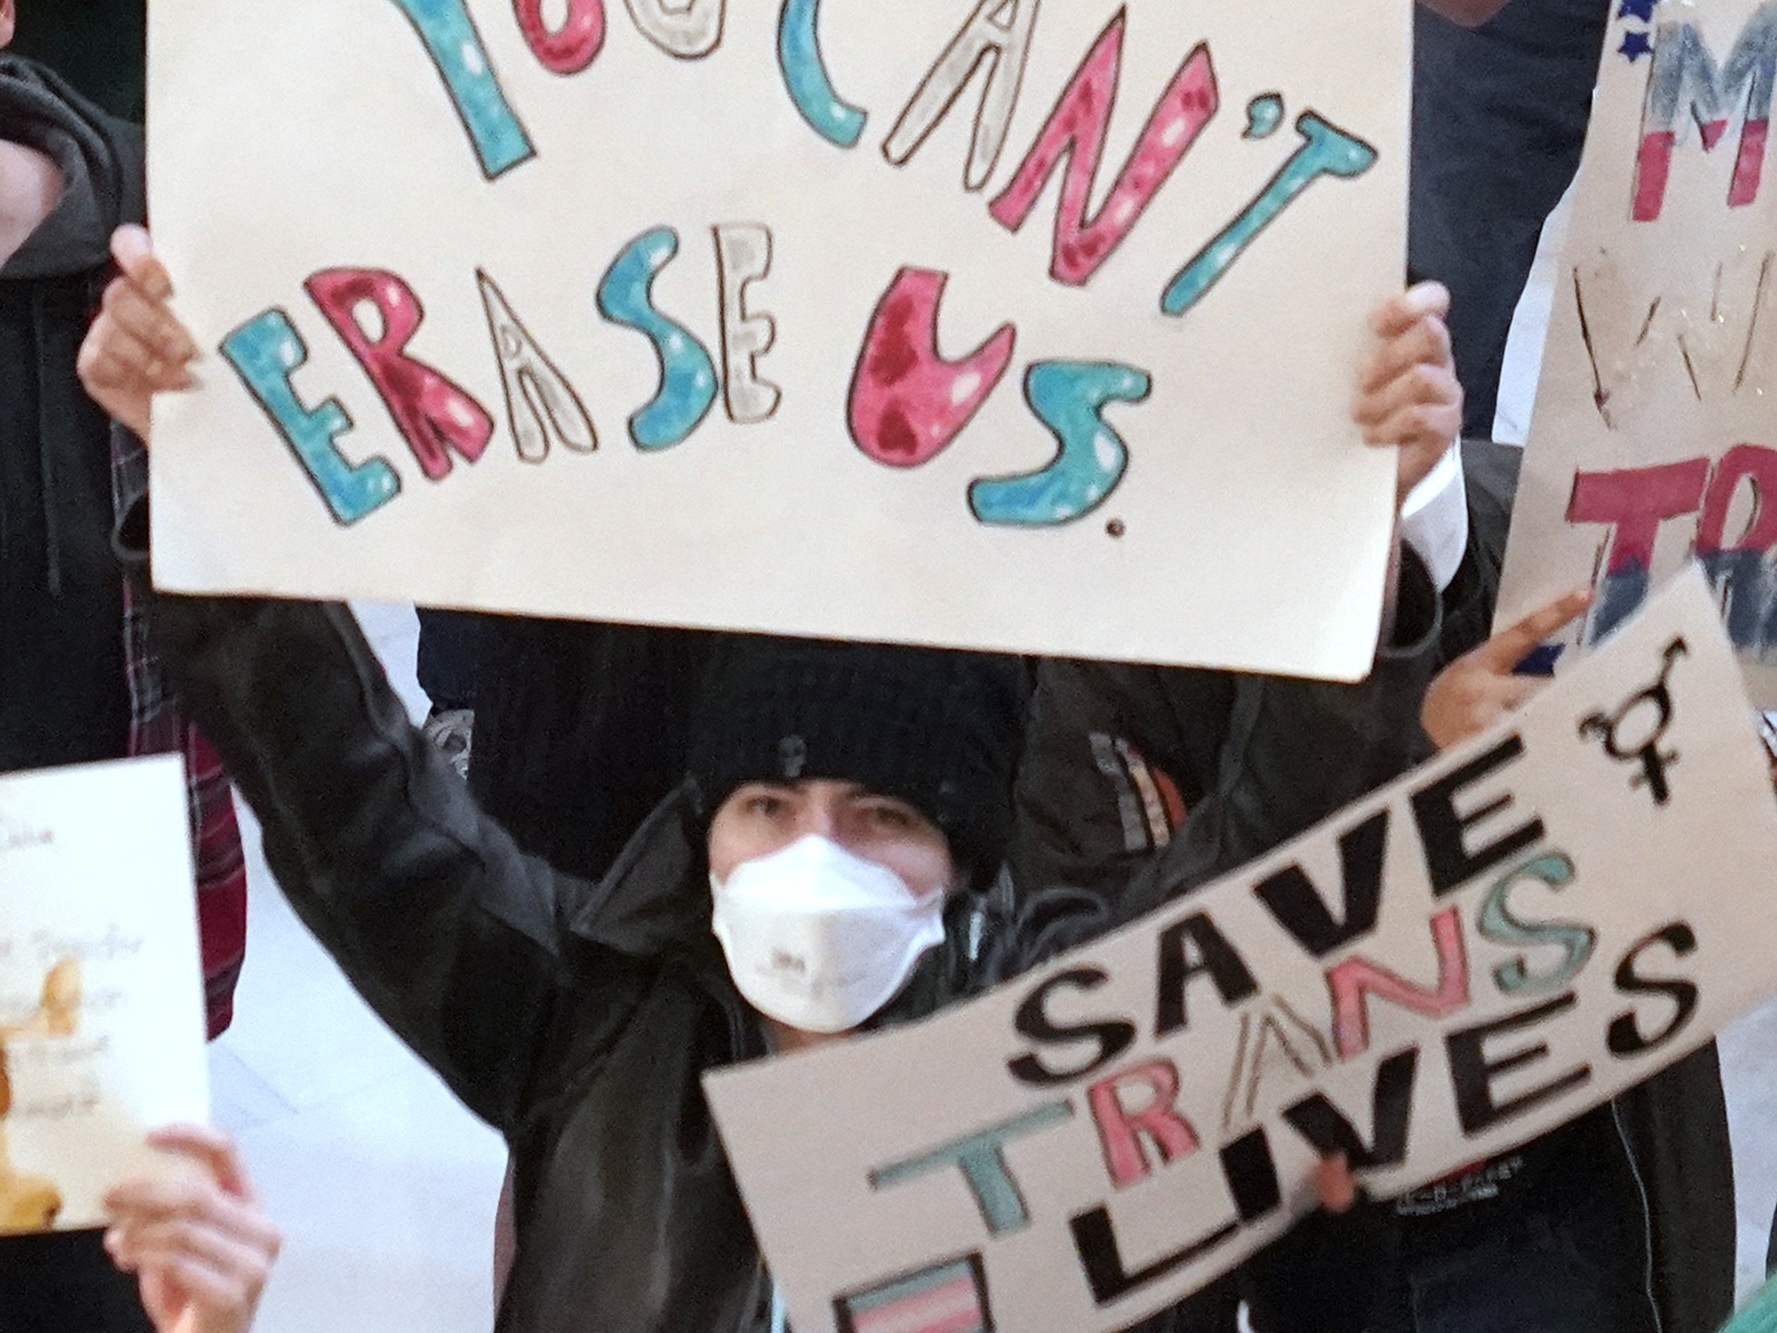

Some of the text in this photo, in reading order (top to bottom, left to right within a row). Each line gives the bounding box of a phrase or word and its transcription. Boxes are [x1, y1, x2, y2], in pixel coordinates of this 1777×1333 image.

[216, 220, 785, 528] ERASE
[865, 852, 1598, 1237] TRANS
[1007, 733, 1546, 1089] SAVE
[1067, 918, 1700, 1305] LIVES
